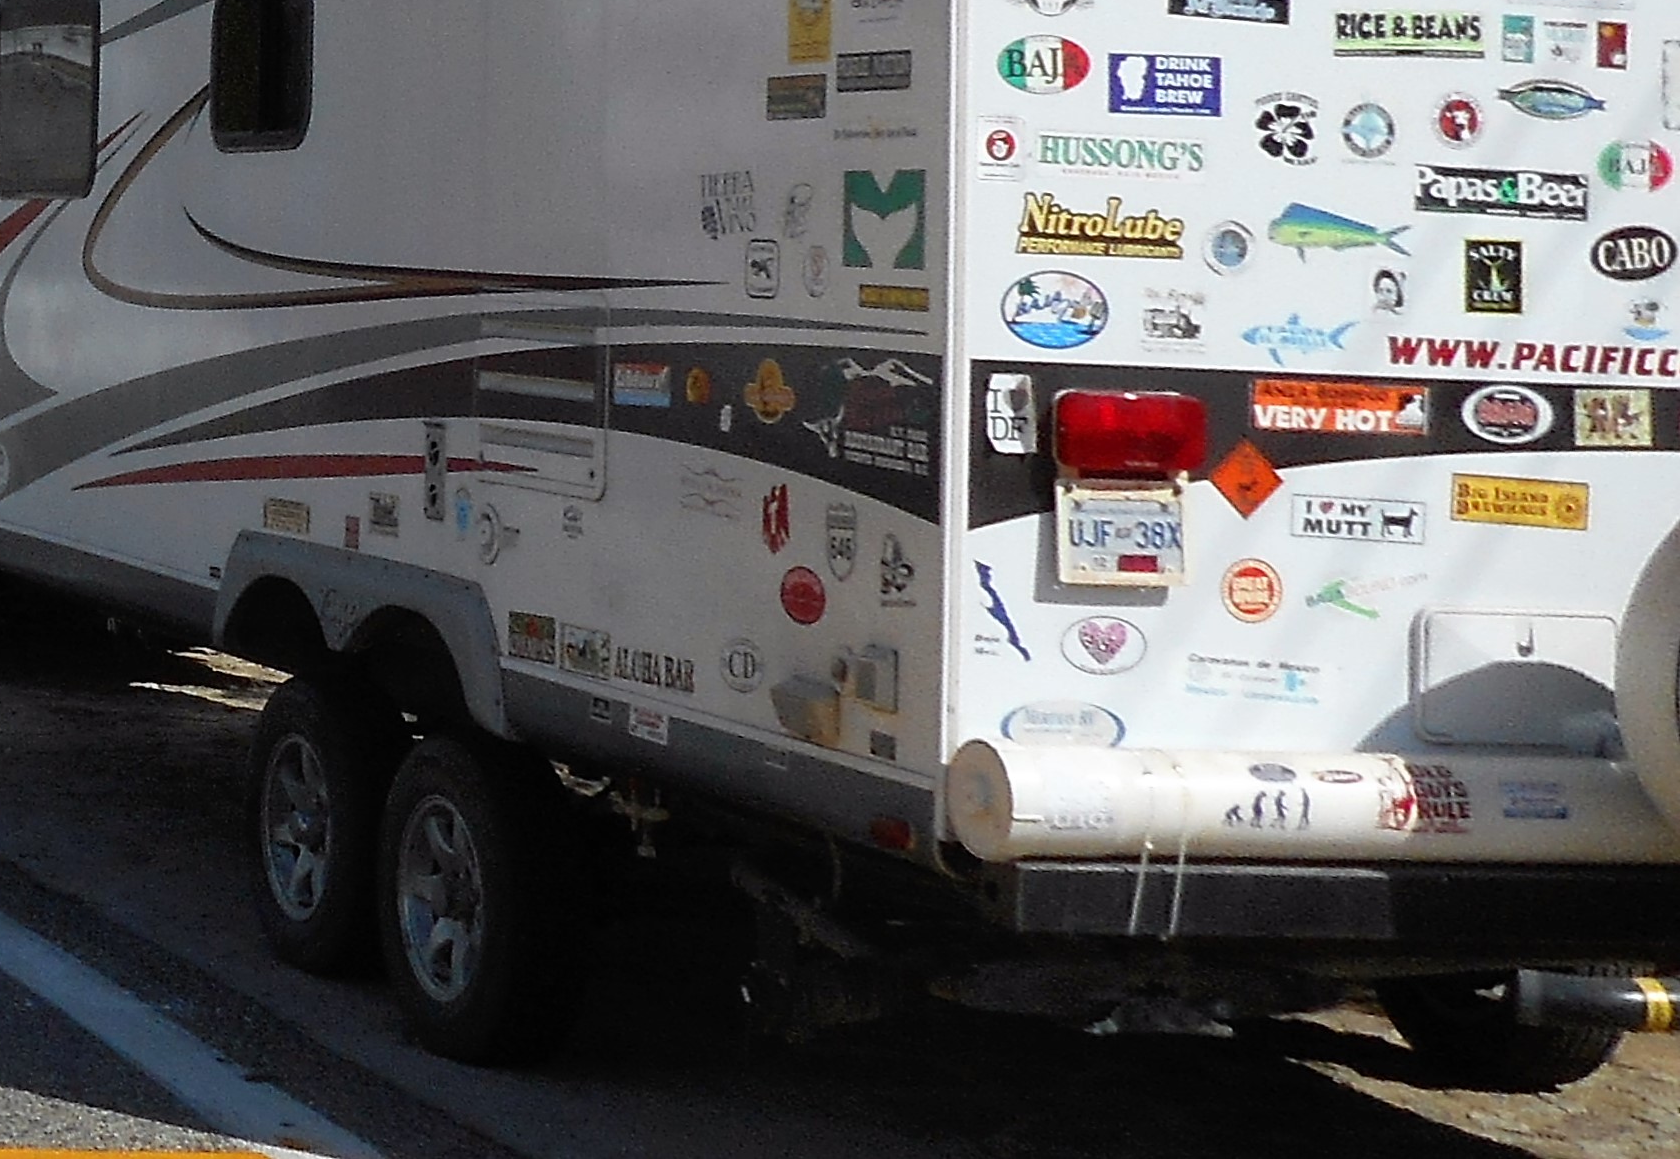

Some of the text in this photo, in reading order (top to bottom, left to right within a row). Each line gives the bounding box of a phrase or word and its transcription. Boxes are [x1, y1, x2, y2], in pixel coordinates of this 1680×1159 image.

[1335, 13, 1482, 41] RICE & BEANS
[1155, 56, 1211, 73] DRINK
[1156, 72, 1213, 89] TAHOE
[1155, 89, 1204, 106] BREW
[1038, 134, 1204, 172] HUSSONG'S
[1018, 192, 1185, 241] NitroLube
[1469, 243, 1518, 261] SALTY
[1597, 236, 1670, 272] CABO
[1388, 336, 1680, 377] WWW.PACIFICC
[991, 416, 1028, 441] DF
[1253, 404, 1393, 432] VERY HOT
[1305, 502, 1371, 519] I MY
[1069, 519, 1183, 549] UJF 38X
[1302, 520, 1373, 537] MUTT
[614, 647, 695, 693] ALOHA BAR
[728, 650, 756, 680] CD
[1414, 781, 1468, 798] GUYS
[1418, 801, 1472, 820] RULE
